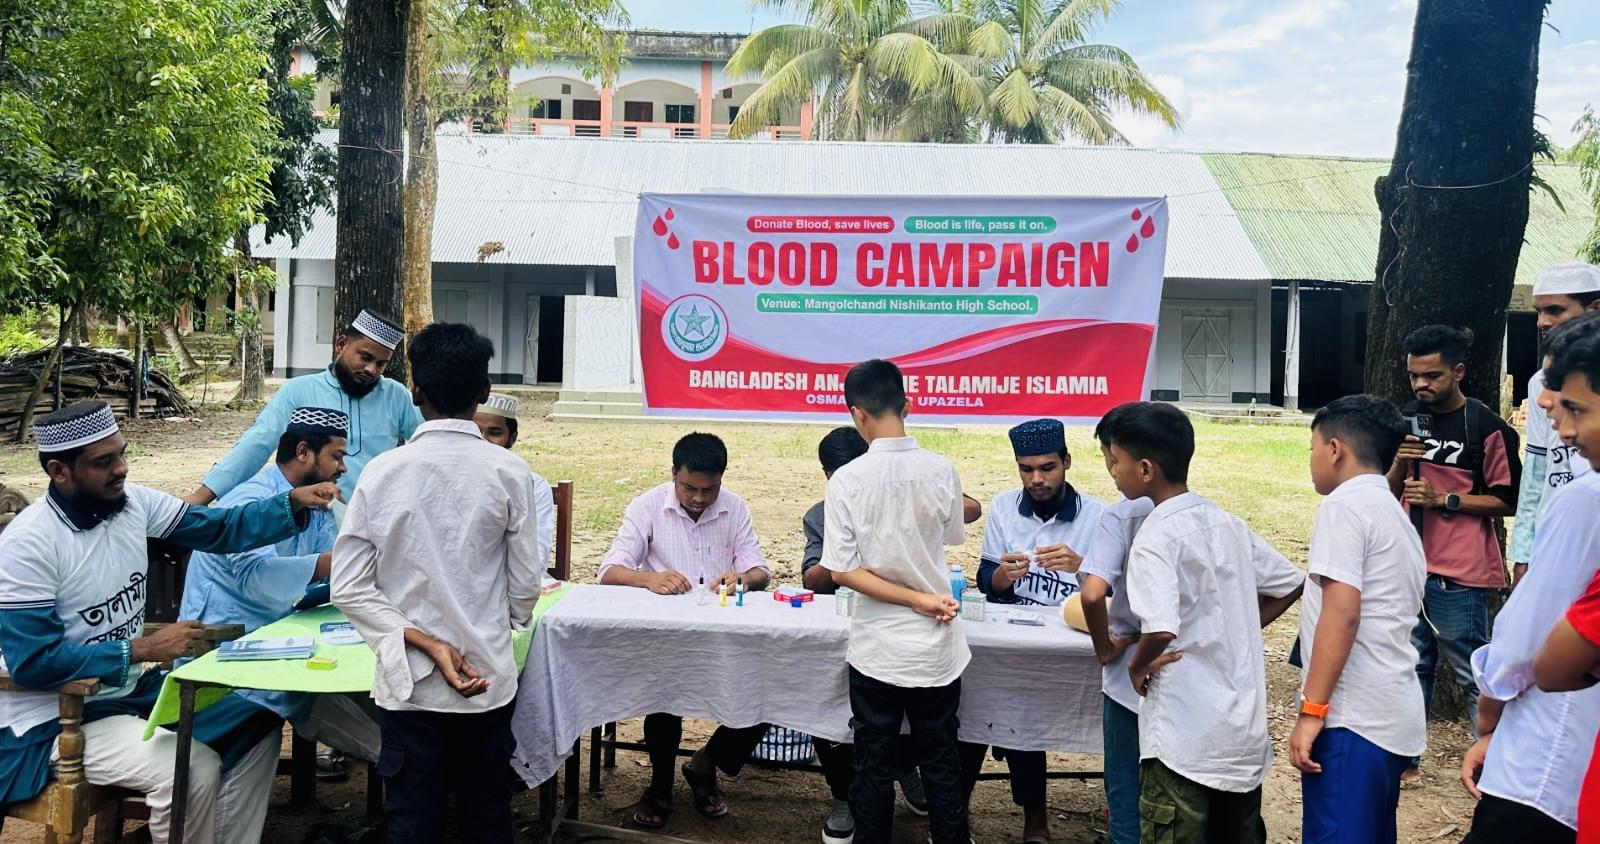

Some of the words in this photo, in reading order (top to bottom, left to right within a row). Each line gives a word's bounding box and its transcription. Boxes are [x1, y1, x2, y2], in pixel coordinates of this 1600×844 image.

[754, 219, 793, 229] Donate
[796, 219, 832, 231] Blood,
[834, 221, 861, 229] save
[863, 219, 889, 229] lives
[915, 219, 949, 230] Blood
[951, 219, 961, 230] is
[964, 219, 985, 231] life,
[988, 221, 1015, 232] pass
[1018, 220, 1026, 230] it
[1029, 221, 1048, 230] on.
[692, 240, 838, 287] BLOOD
[856, 241, 1110, 288] CAMPAIGN
[761, 298, 801, 309] Venue:
[805, 299, 887, 311] Mangolchandi
[890, 300, 953, 311] Nishikanto
[956, 300, 984, 312] High
[987, 300, 1033, 311] School.
[689, 369, 808, 391] BANGLADESH
[925, 375, 1020, 394] TALAMIJE
[1026, 376, 1109, 395] ISLAMIA
[917, 396, 984, 407] UPAZELA
